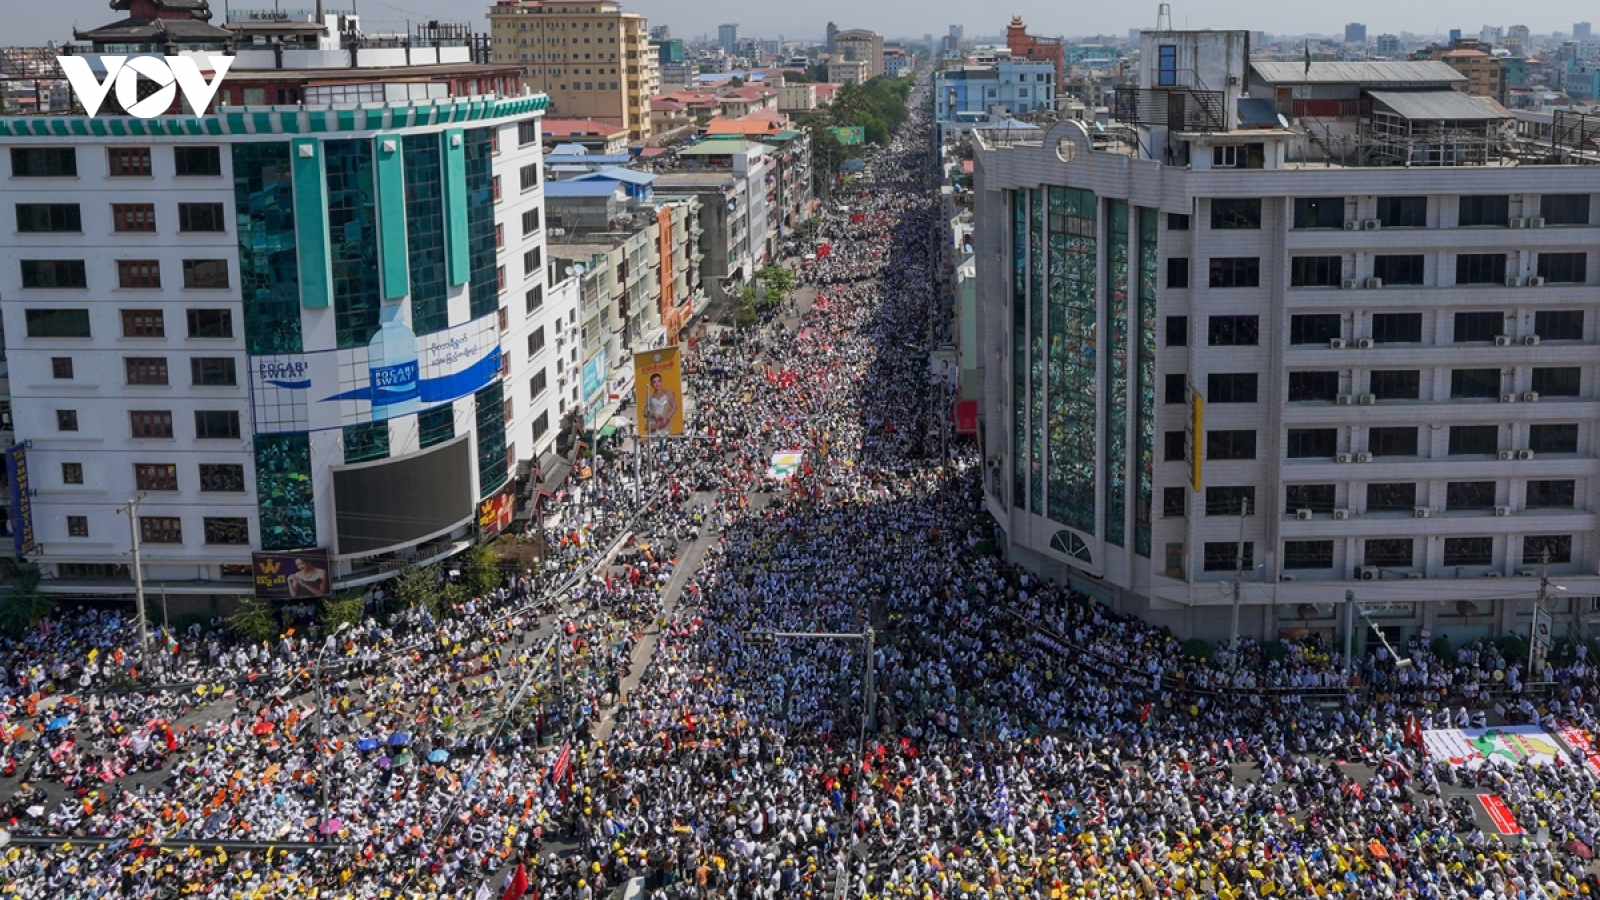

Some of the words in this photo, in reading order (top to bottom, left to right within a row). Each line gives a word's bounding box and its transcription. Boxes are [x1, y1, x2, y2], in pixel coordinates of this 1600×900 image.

[260, 362, 308, 371] POCARI
[260, 369, 303, 379] SWEAT
[376, 366, 414, 379] POCARI
[376, 374, 411, 386] SWEAT
